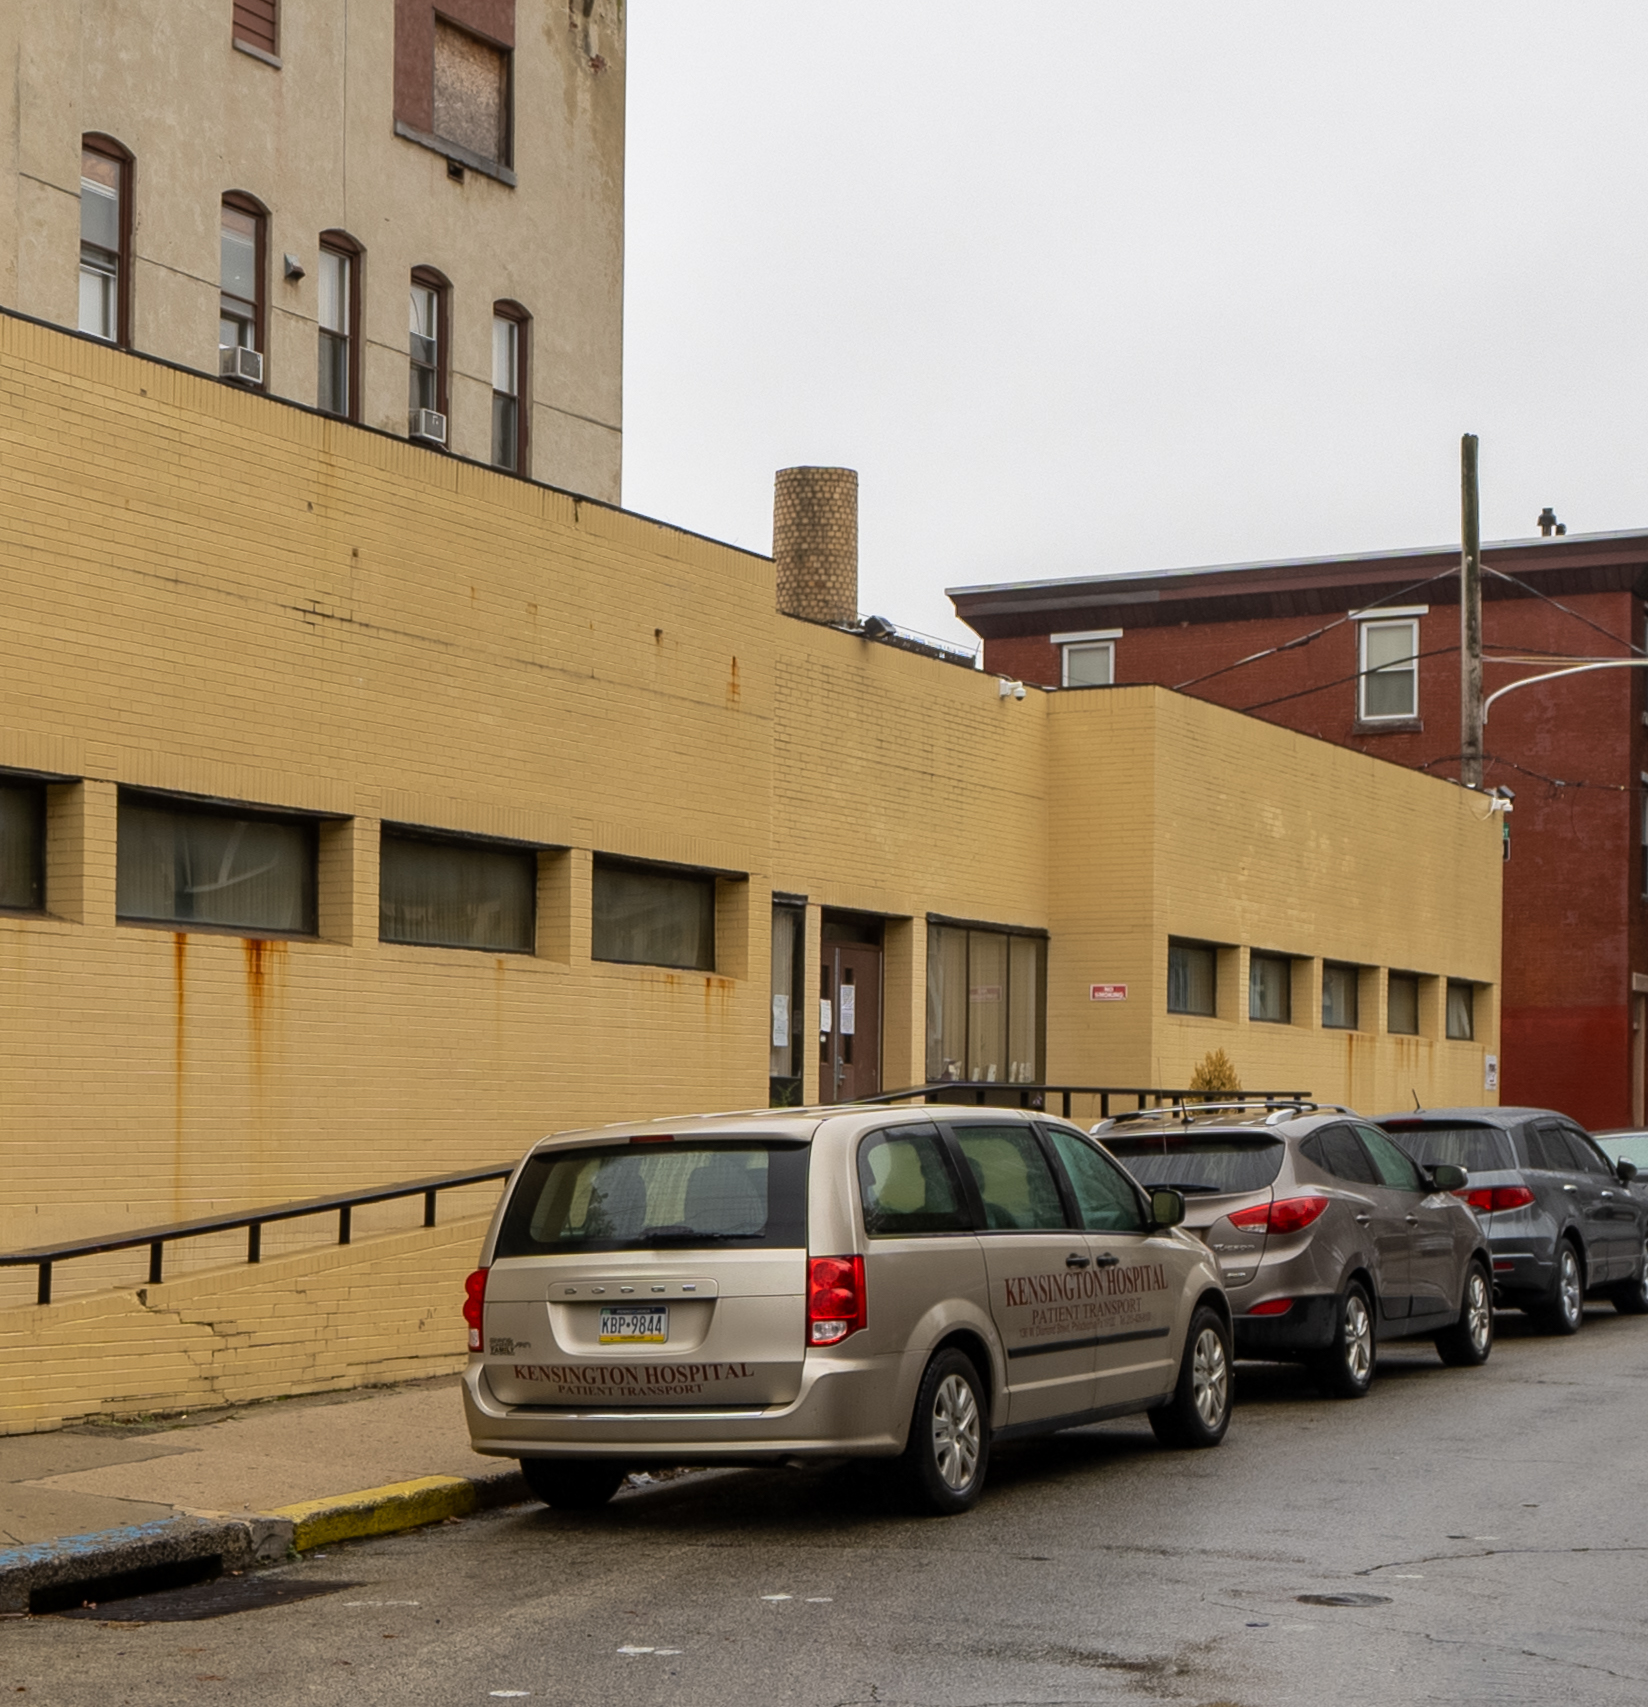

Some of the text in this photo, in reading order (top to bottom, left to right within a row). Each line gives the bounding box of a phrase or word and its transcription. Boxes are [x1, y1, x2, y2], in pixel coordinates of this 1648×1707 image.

[1004, 1263, 1168, 1308] KENSINGTON HOSPITAL
[1032, 1303, 1080, 1325] PATIENT
[1082, 1298, 1142, 1319] TRANSPORT
[514, 1362, 755, 1385] KENSINGTON HOSPITAL
[558, 1383, 704, 1397] PATIENT TRANSPORT
